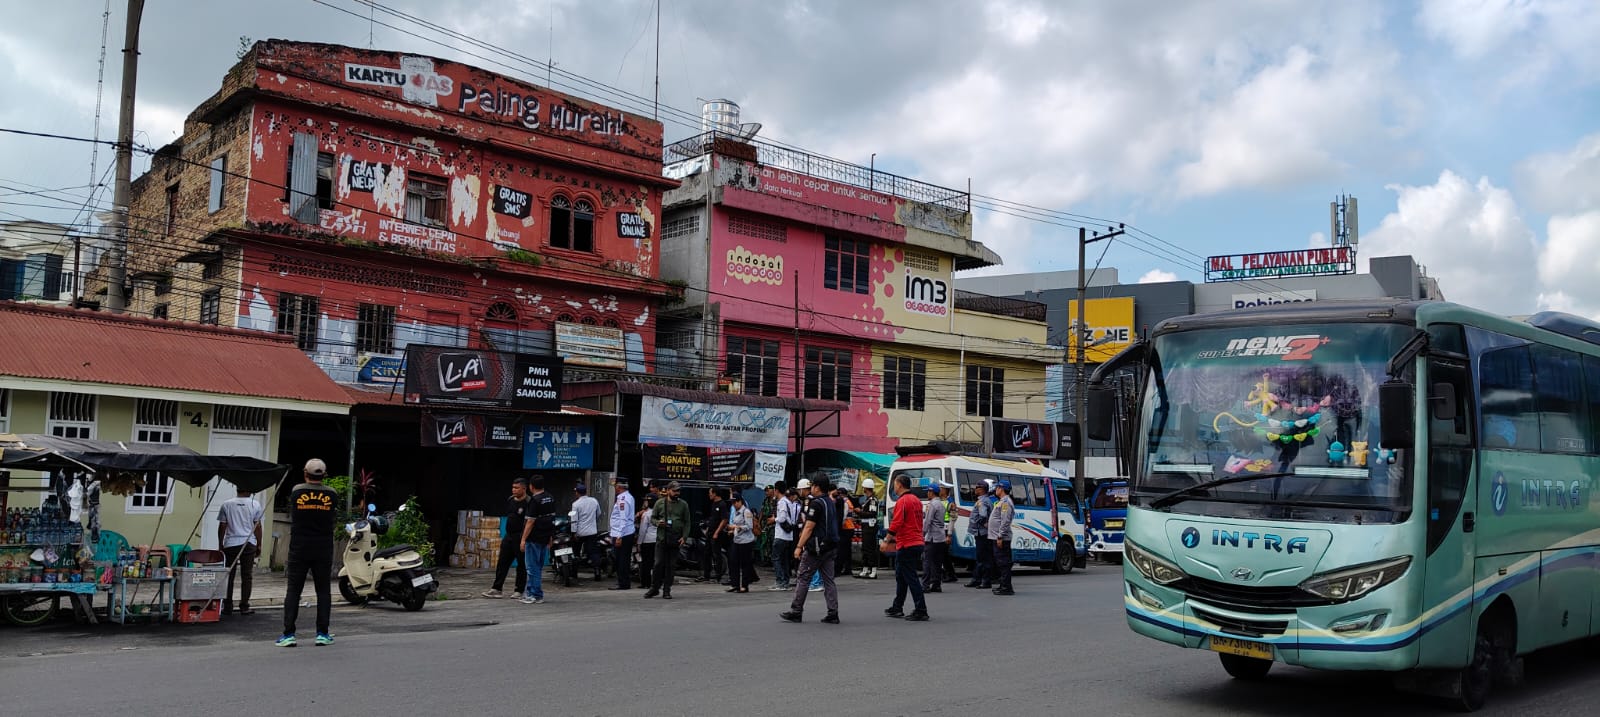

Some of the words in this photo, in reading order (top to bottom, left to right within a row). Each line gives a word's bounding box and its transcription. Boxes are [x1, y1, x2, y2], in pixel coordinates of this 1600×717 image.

[348, 66, 406, 86] KARTU
[426, 75, 451, 92] AS
[458, 82, 541, 129] Paling
[353, 162, 385, 178] GRATS
[763, 181, 779, 193] data
[778, 172, 801, 186] lebih
[804, 179, 830, 193] cepat
[832, 186, 856, 198] untuk
[859, 192, 888, 206] semua
[499, 187, 527, 207] GRATIS
[504, 202, 521, 216] SMS
[620, 213, 645, 226] GRATIS
[379, 219, 427, 238] INTERNET
[621, 224, 646, 237] ONLINE
[379, 231, 388, 242] &
[730, 254, 780, 270] indosat
[1211, 256, 1234, 271] MAL
[1242, 251, 1305, 269] PELAYANAN
[1307, 248, 1349, 264] PUBLIK
[1222, 269, 1246, 279] KOTA
[905, 268, 947, 304] im3
[1226, 336, 1291, 350] new
[1239, 347, 1293, 357] JETBUS
[528, 366, 549, 376] PMH
[522, 377, 552, 388] MULIA
[516, 388, 557, 400] SAMOSIR
[738, 406, 789, 430] Baru
[660, 455, 701, 466] SIGNATURE
[762, 462, 784, 474] GGSP
[296, 491, 332, 506] POLISI
[1521, 479, 1581, 510] INTRA
[1212, 529, 1309, 555] INTRA
